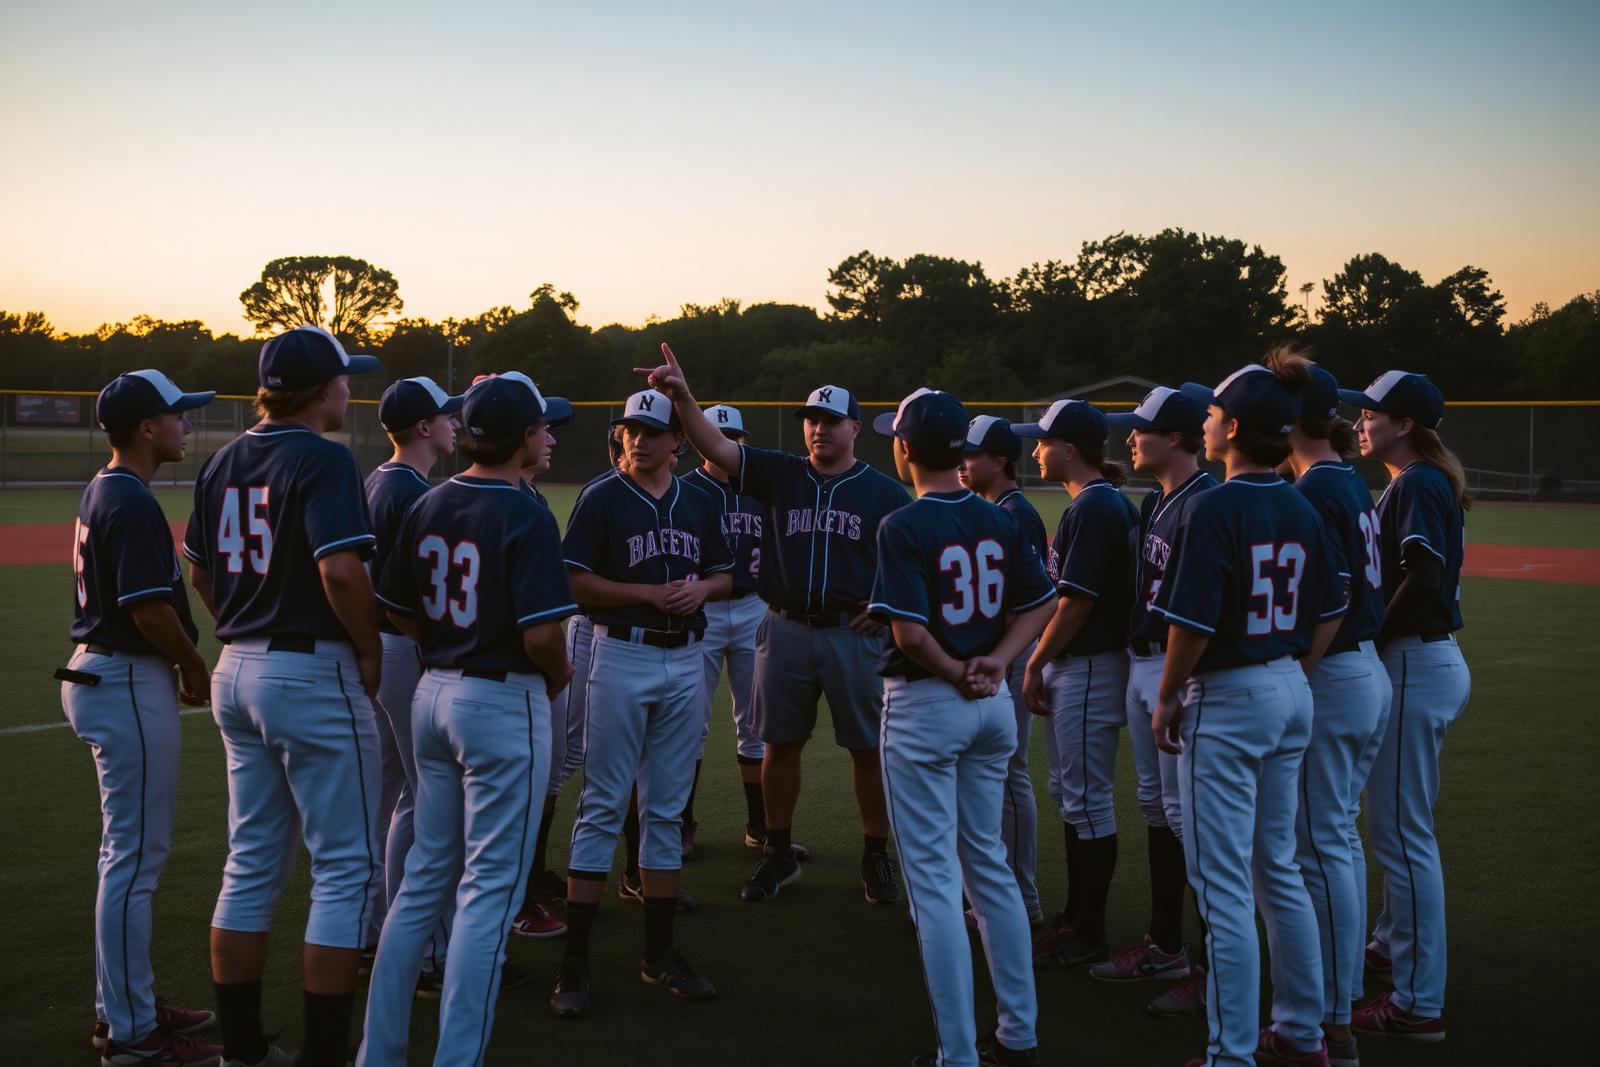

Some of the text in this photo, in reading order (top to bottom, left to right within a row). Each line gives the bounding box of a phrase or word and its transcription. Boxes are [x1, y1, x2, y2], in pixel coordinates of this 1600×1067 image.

[216, 485, 274, 575] 45
[416, 532, 481, 630] 33
[938, 537, 1005, 627] 36
[1246, 541, 1307, 636] 53
